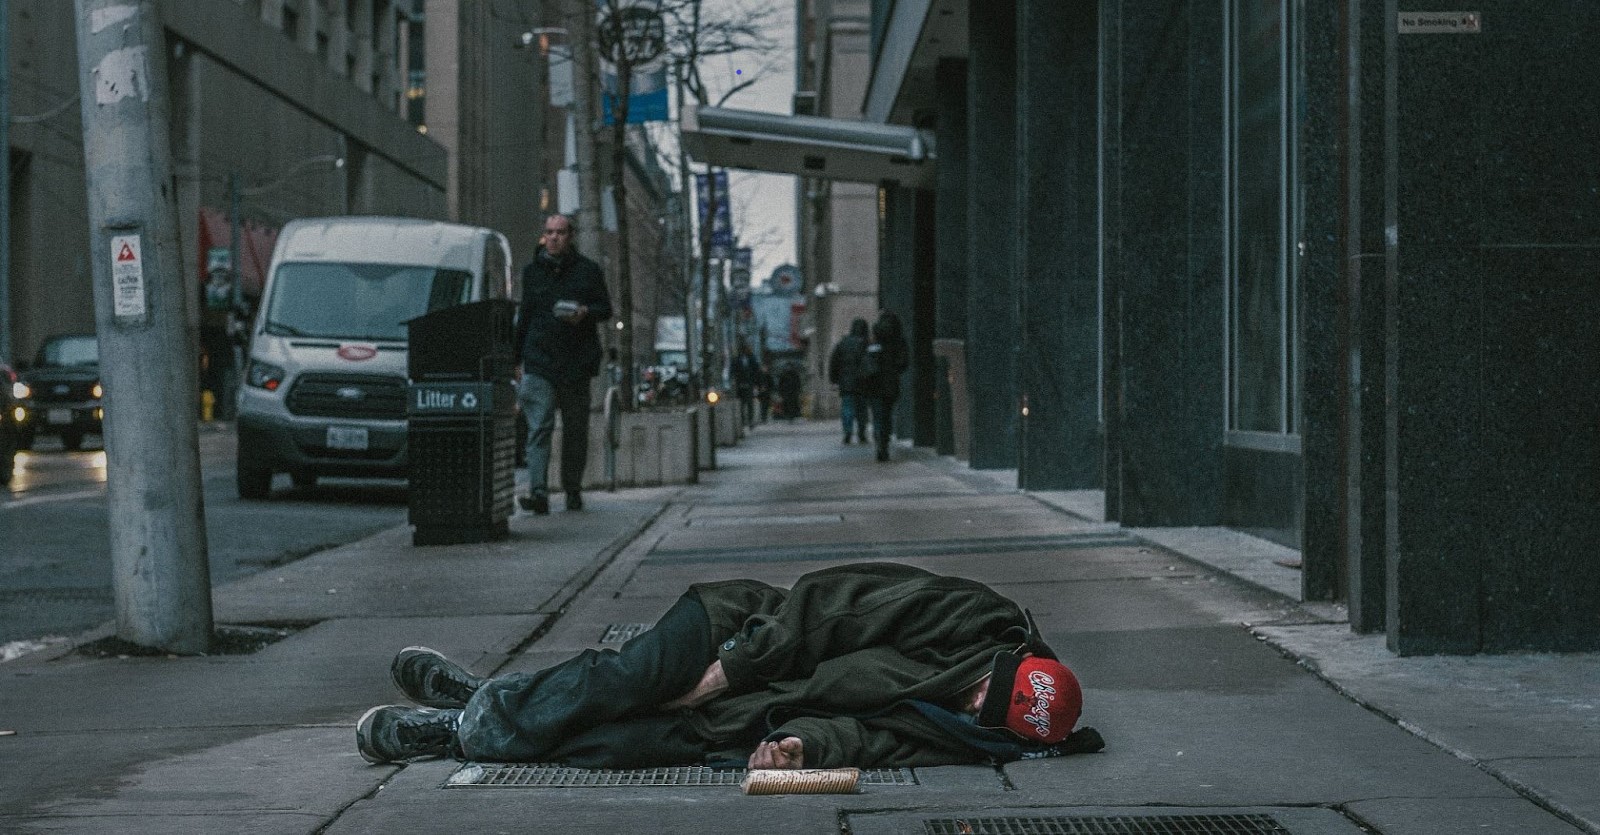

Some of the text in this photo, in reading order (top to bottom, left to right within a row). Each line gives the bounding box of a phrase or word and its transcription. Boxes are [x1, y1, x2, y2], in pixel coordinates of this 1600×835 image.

[1402, 17, 1458, 28] No Smoking
[417, 389, 456, 409] Litter
[1024, 670, 1057, 737] Chicago
